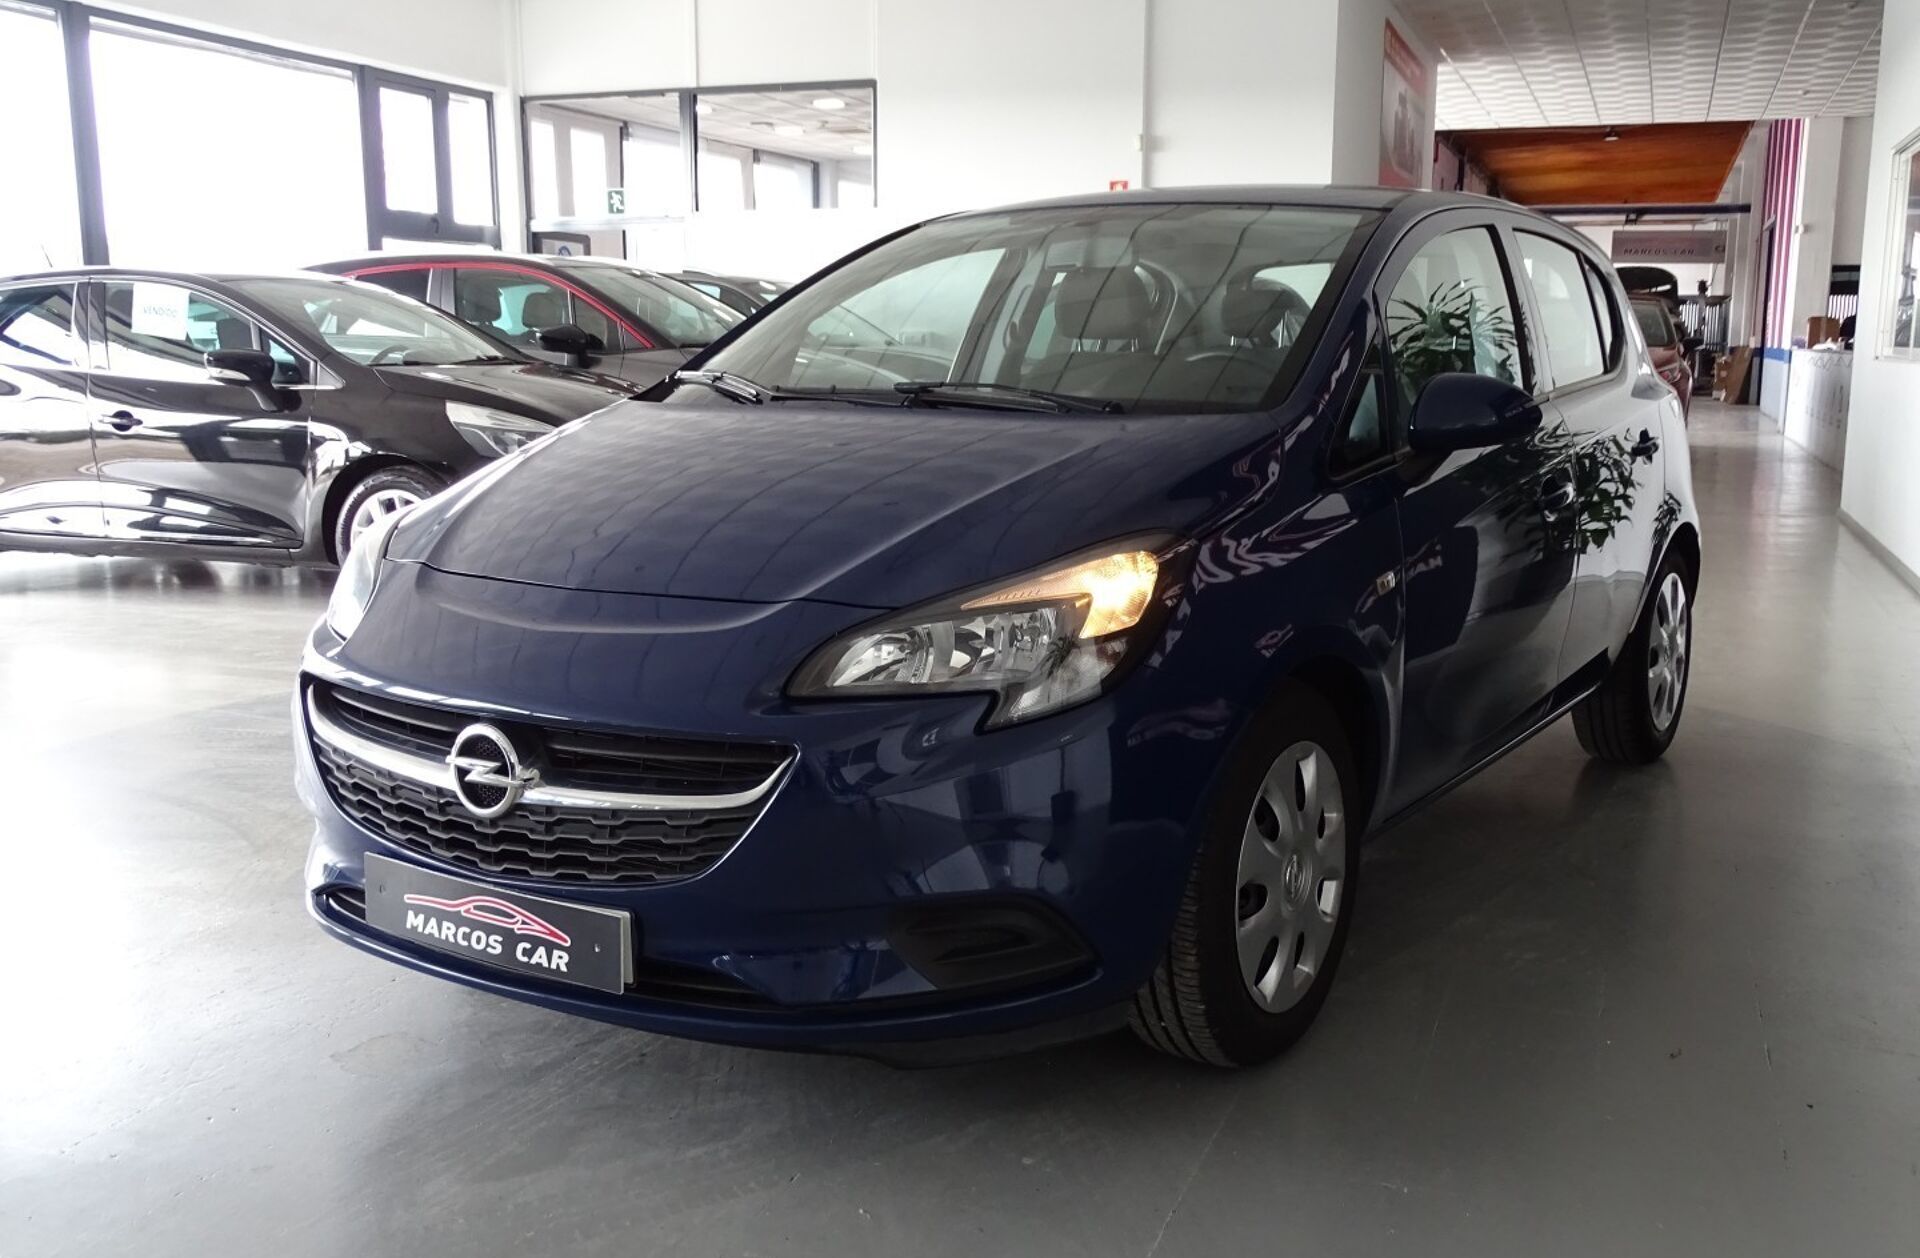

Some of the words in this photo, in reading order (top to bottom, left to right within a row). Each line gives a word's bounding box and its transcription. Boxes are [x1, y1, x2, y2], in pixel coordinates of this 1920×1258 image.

[1623, 247, 1668, 256] MARCOS
[1672, 247, 1695, 256] CAR
[405, 910, 503, 955] MARCOS
[515, 942, 570, 973] CAR
